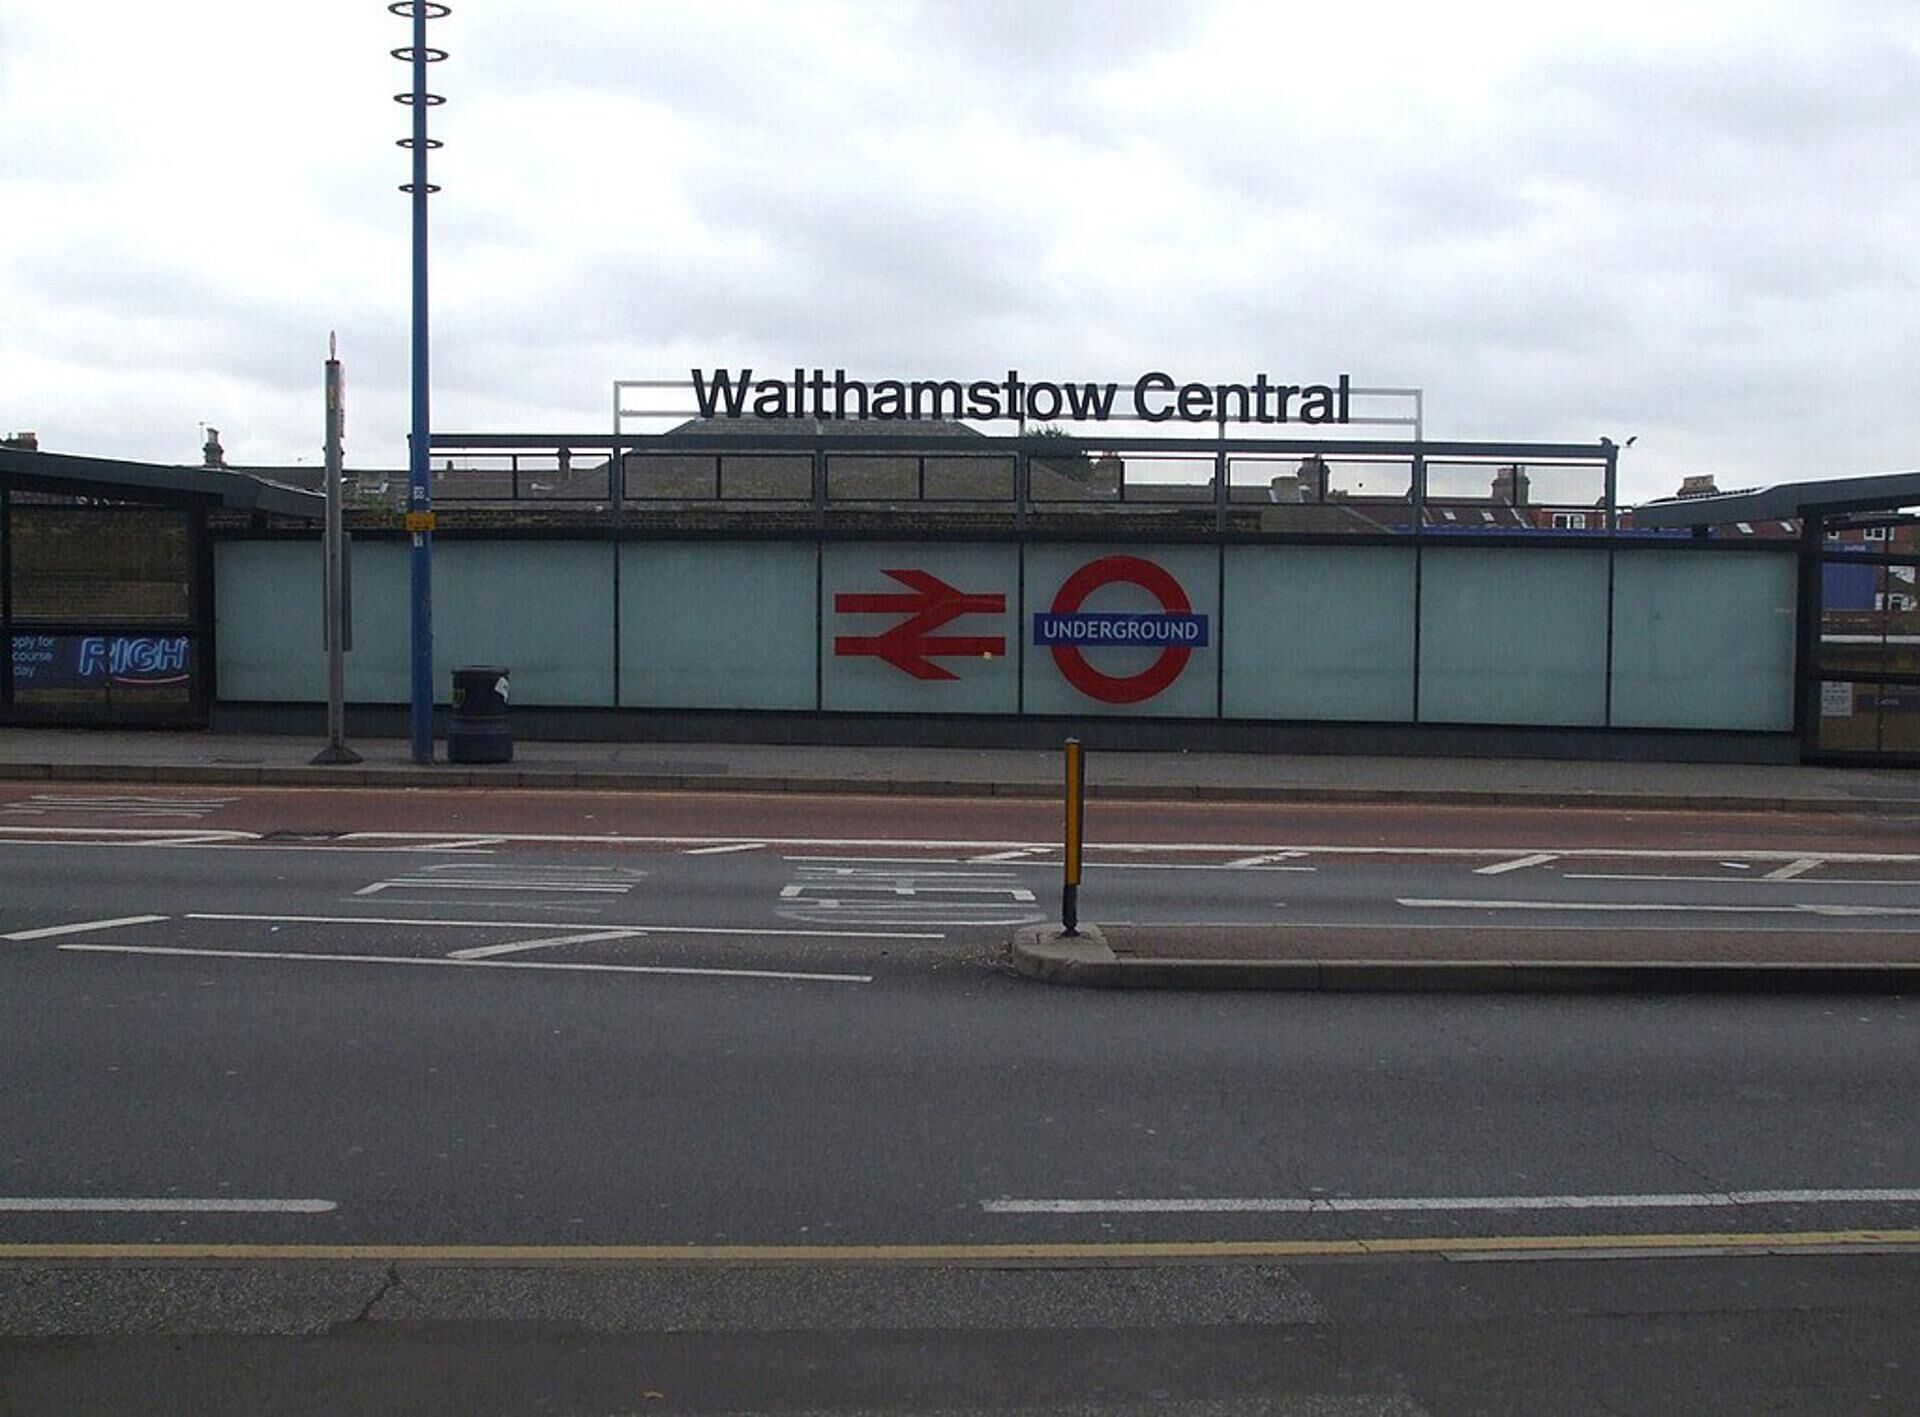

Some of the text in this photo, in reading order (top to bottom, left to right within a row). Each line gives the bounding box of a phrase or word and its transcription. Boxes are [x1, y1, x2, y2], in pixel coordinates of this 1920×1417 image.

[691, 369, 1350, 424] Walthamstow Central
[11, 635, 36, 650] pply
[1043, 620, 1199, 640] UNDERGROUND
[79, 636, 189, 676] RIGH
